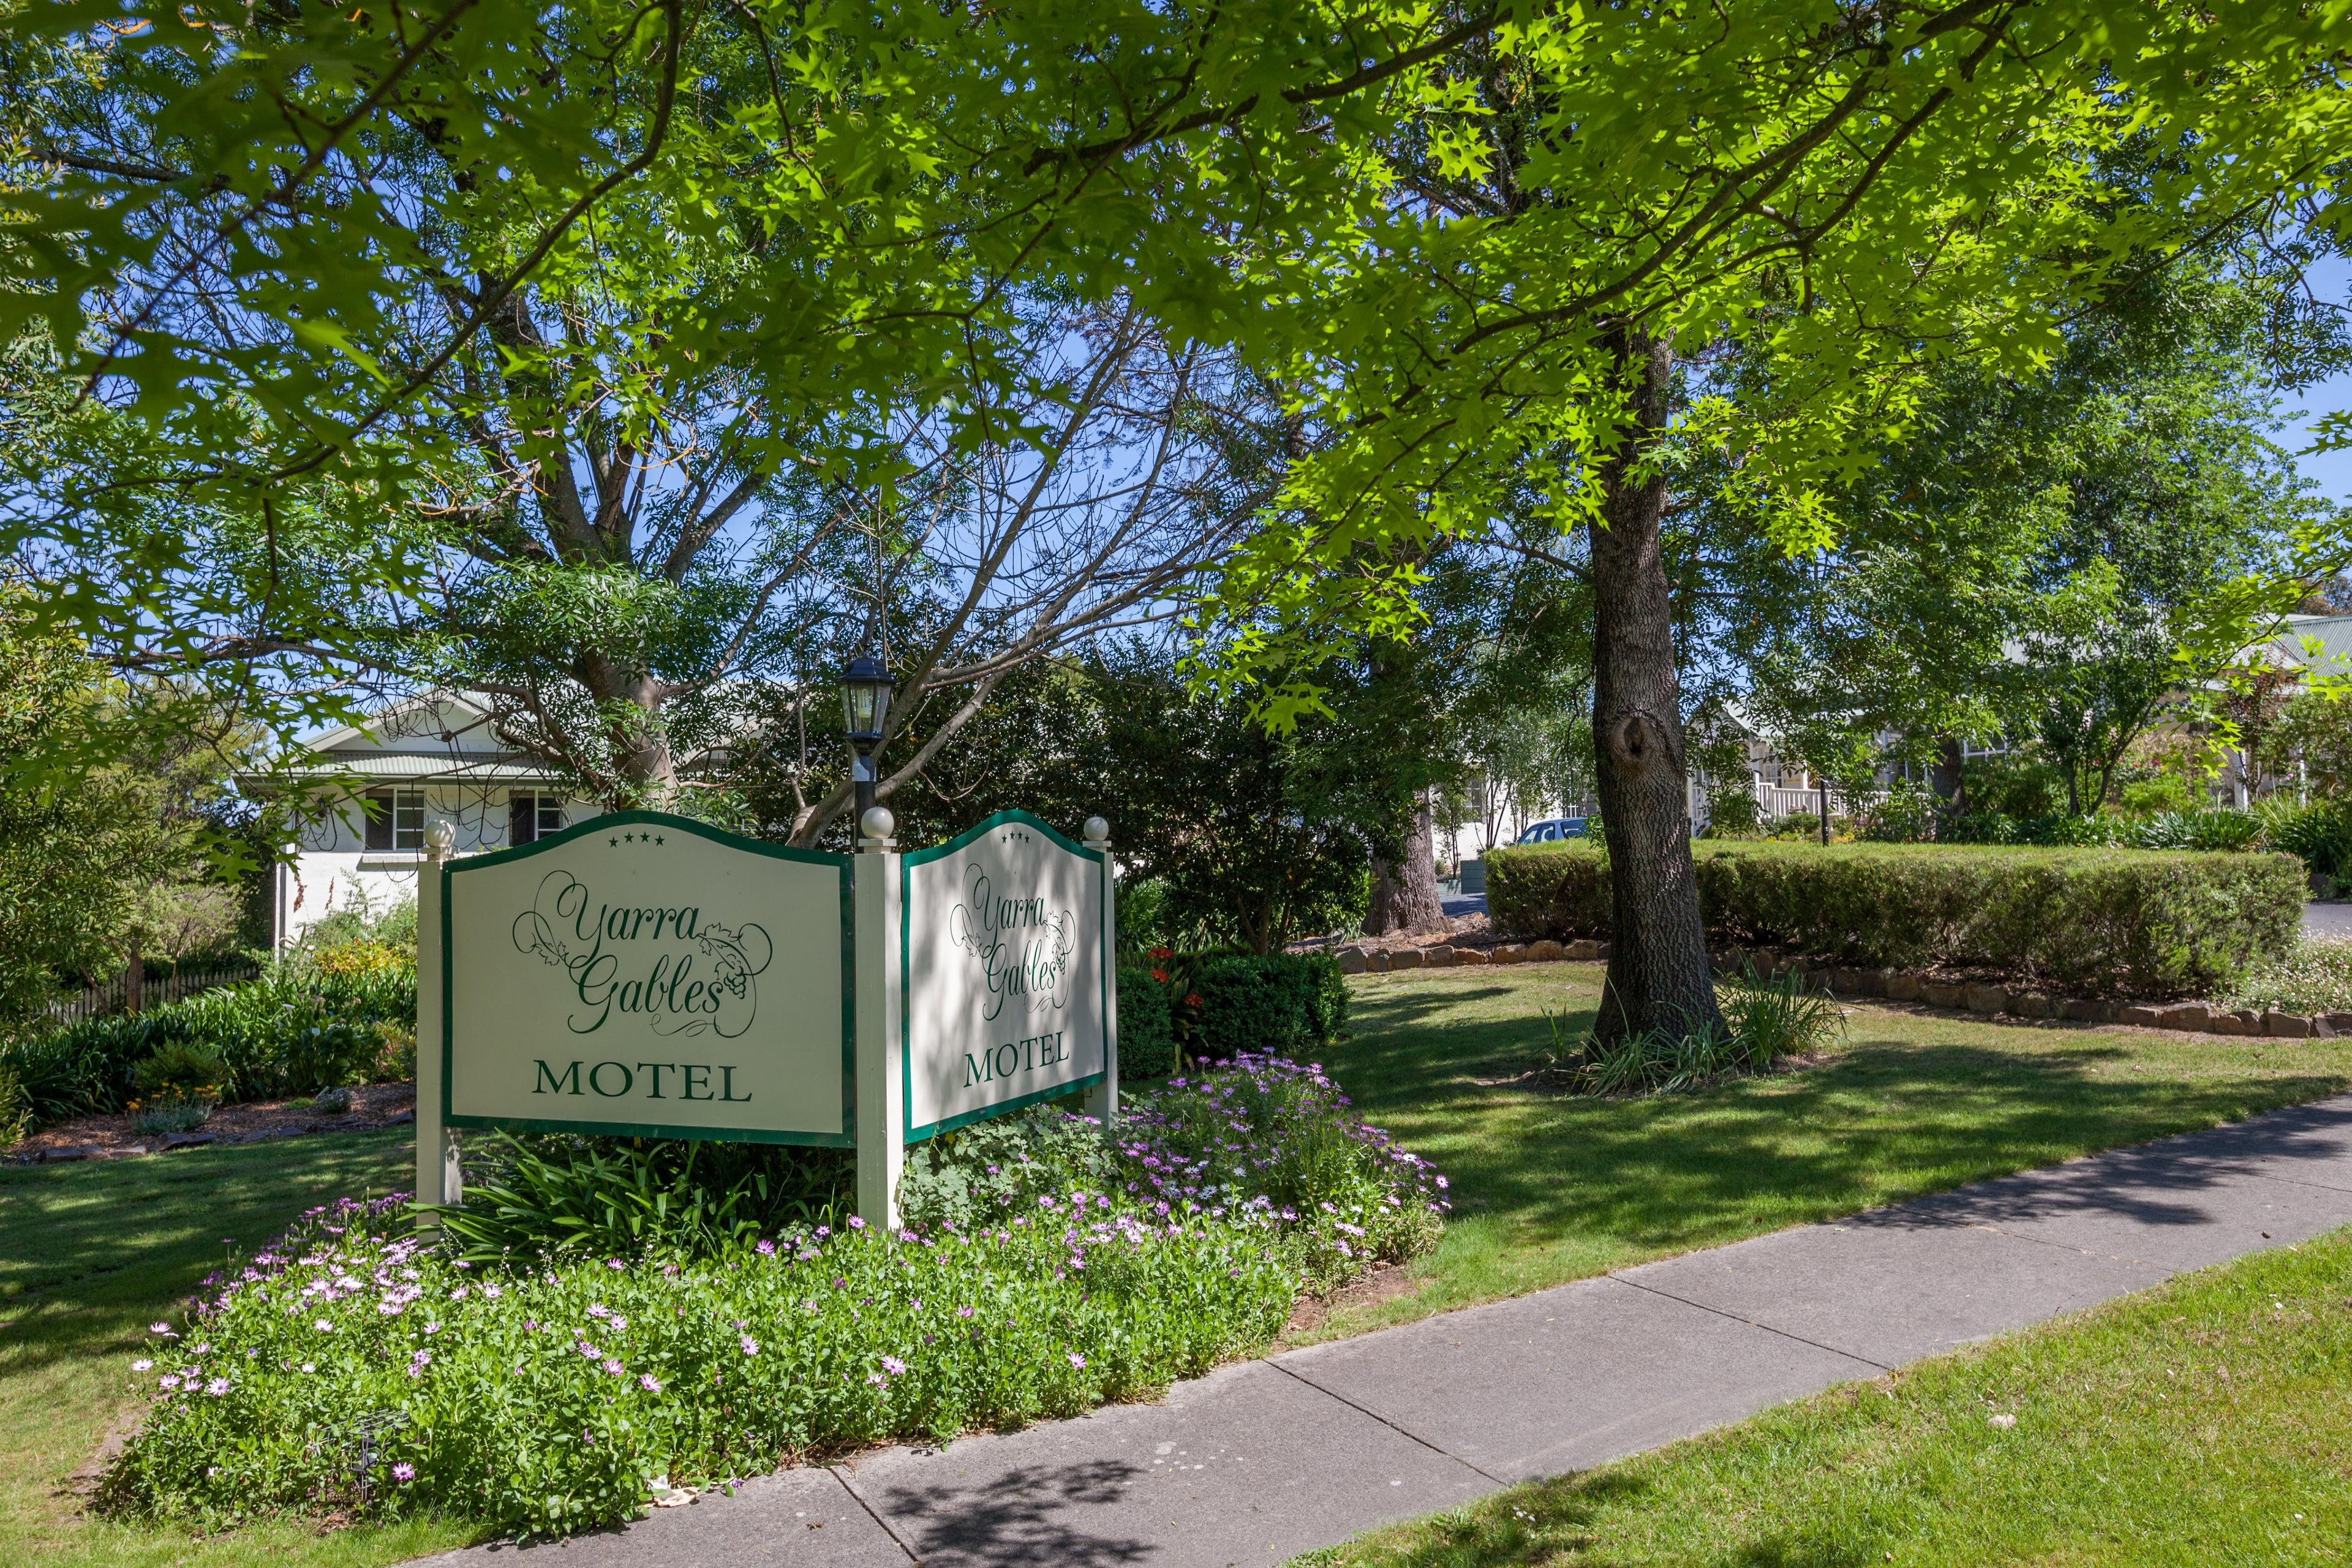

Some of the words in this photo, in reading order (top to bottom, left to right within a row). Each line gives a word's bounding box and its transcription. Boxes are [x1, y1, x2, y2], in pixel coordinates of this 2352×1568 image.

[557, 883, 699, 969] Yarra
[974, 876, 1045, 959] Yarra
[568, 954, 724, 1034] Gables
[982, 940, 1057, 1020] Gables
[531, 1060, 753, 1102] MOTEL
[963, 1031, 1069, 1088] MOTEL
